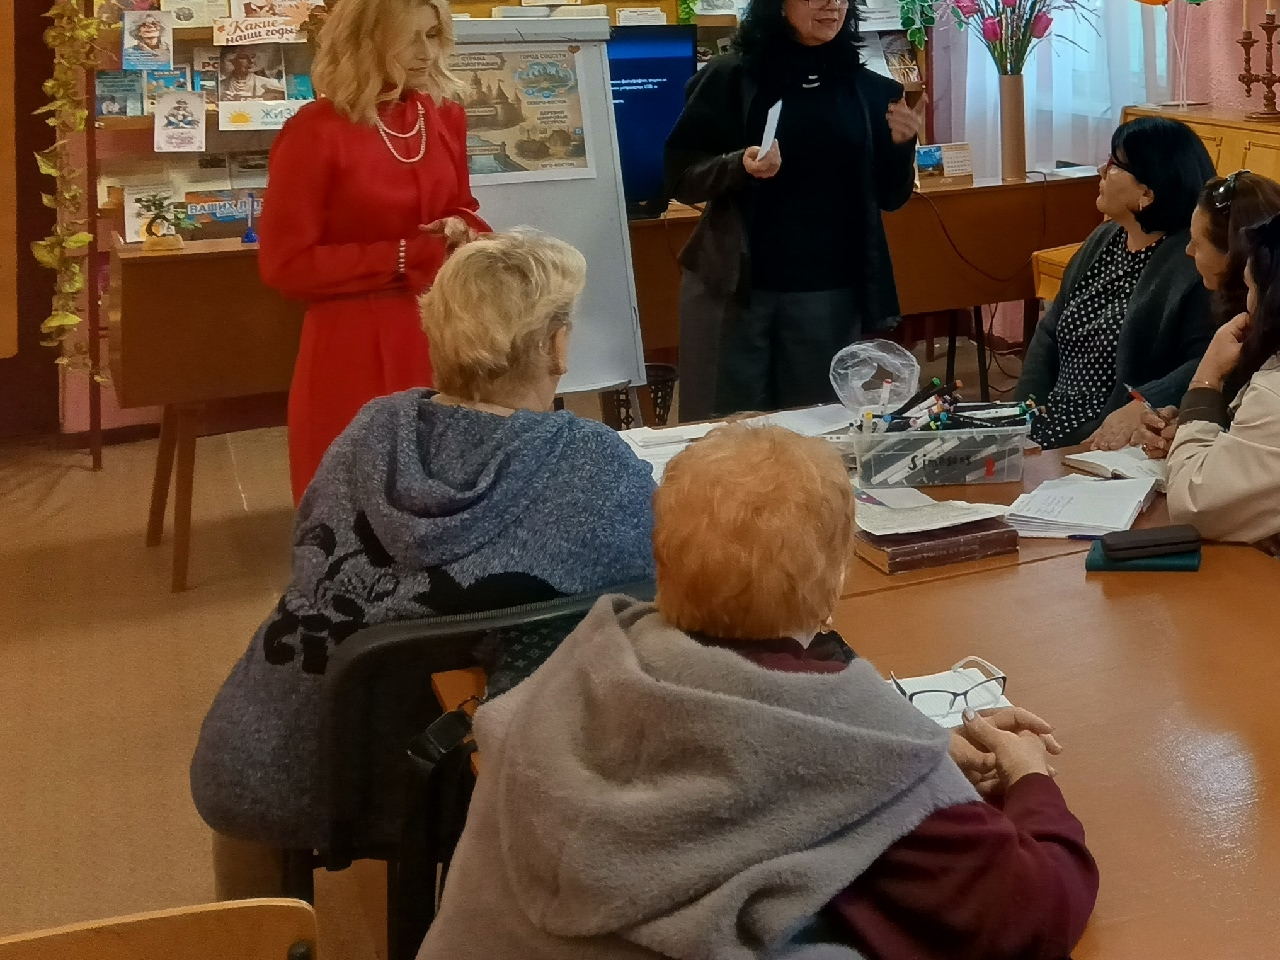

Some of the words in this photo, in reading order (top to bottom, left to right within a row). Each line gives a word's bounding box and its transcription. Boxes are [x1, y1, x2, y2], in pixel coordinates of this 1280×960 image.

[227, 19, 279, 36] Какие
[226, 29, 263, 45] наши
[189, 200, 237, 213] ВАШИХ
